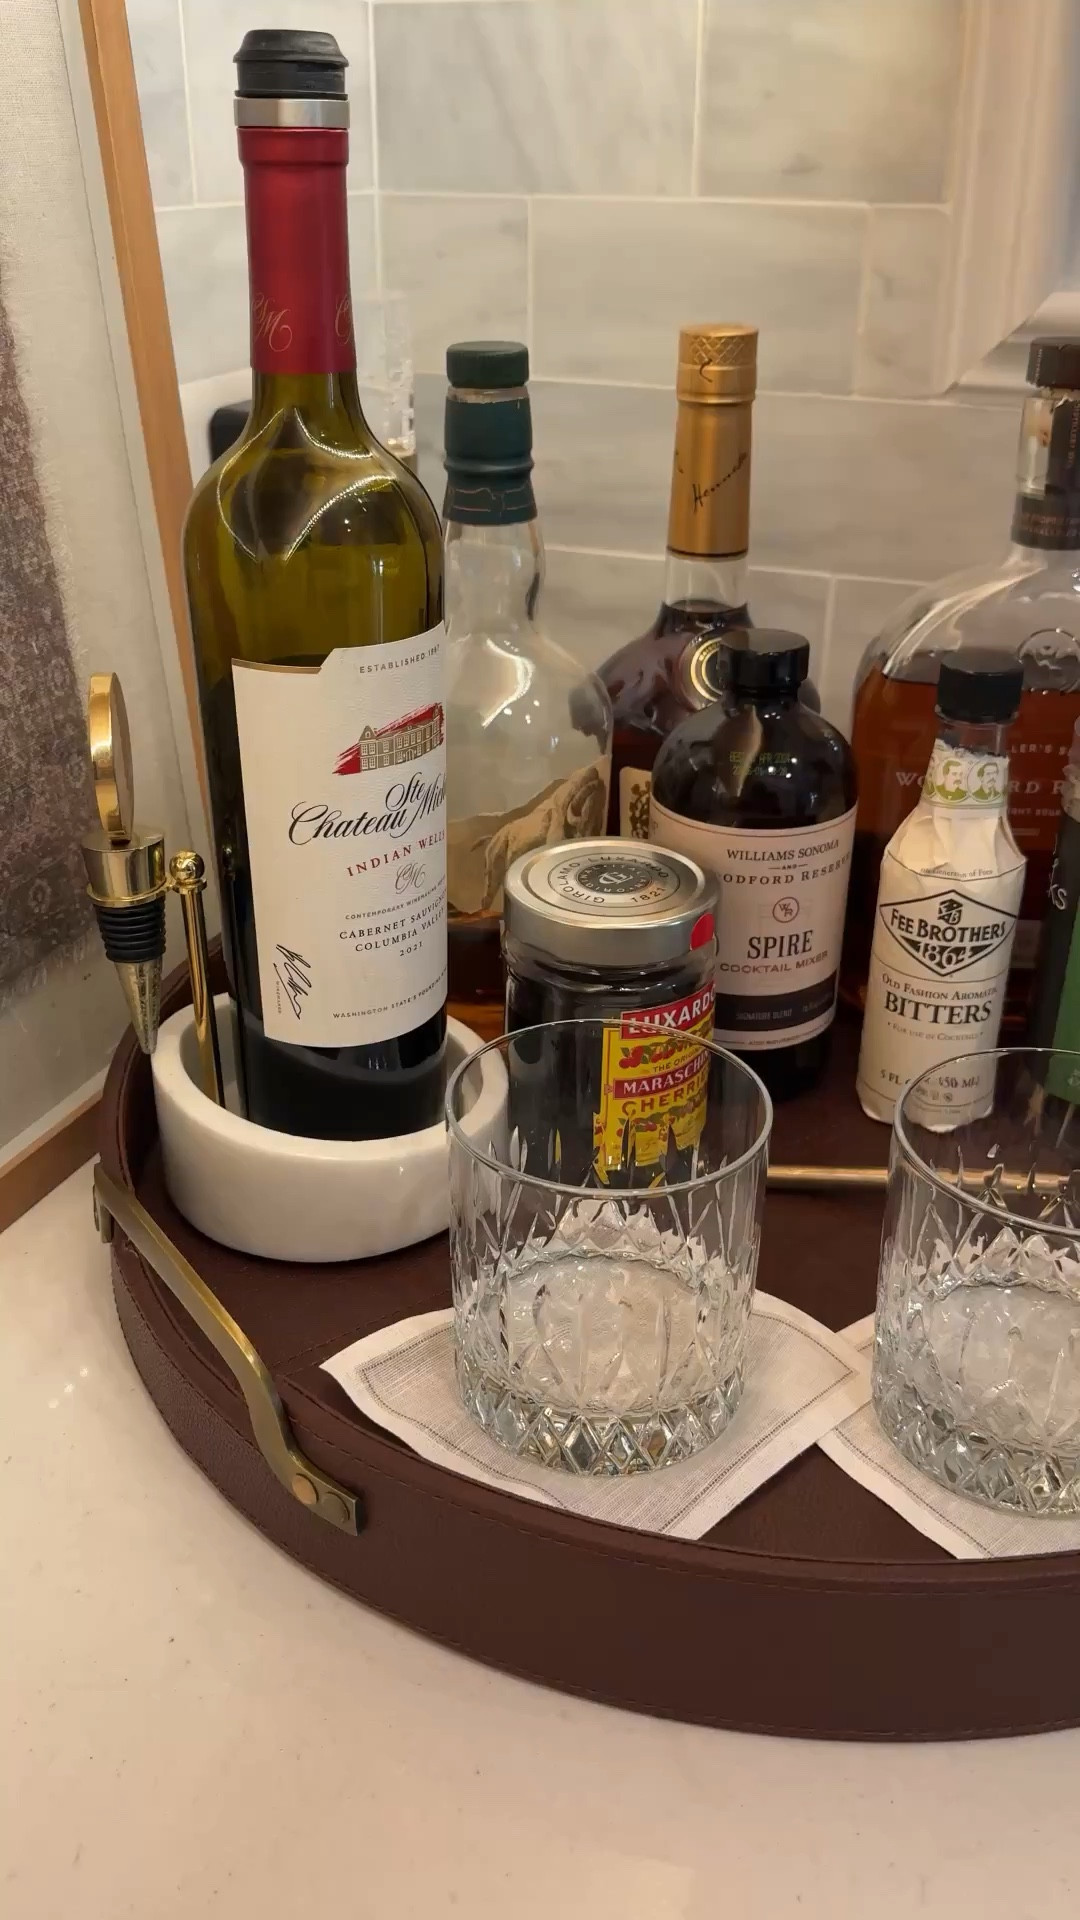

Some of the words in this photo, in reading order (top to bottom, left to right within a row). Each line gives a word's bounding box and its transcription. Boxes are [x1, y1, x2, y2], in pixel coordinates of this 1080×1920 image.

[359, 652, 426, 674] ESTABLISHED
[385, 771, 426, 812] Ste
[288, 801, 408, 846] Chateau
[346, 844, 413, 877] INDIAN
[726, 849, 795, 862] WILLIAMS
[797, 839, 839, 859] SONOMA
[781, 863, 797, 871] AND
[557, 862, 605, 904] GIROLAMO
[722, 873, 795, 886] ODFORD
[630, 887, 667, 903] 1821
[345, 903, 404, 921] CONTEMPORARY
[339, 918, 406, 940] CABERNET
[890, 907, 915, 935] FEE
[916, 917, 1006, 943] BROTHERS
[355, 928, 418, 952] COLUMBIA
[399, 941, 423, 957] 2021
[747, 929, 814, 960] SPIRE
[720, 963, 791, 974] COCKTAIL
[795, 950, 828, 970] MIXER
[882, 972, 901, 990] OLD
[903, 982, 949, 1001] FASHION
[333, 1006, 388, 1019] WASHINGTON
[884, 989, 992, 1025] BITTERS
[653, 1063, 672, 1074] THE
